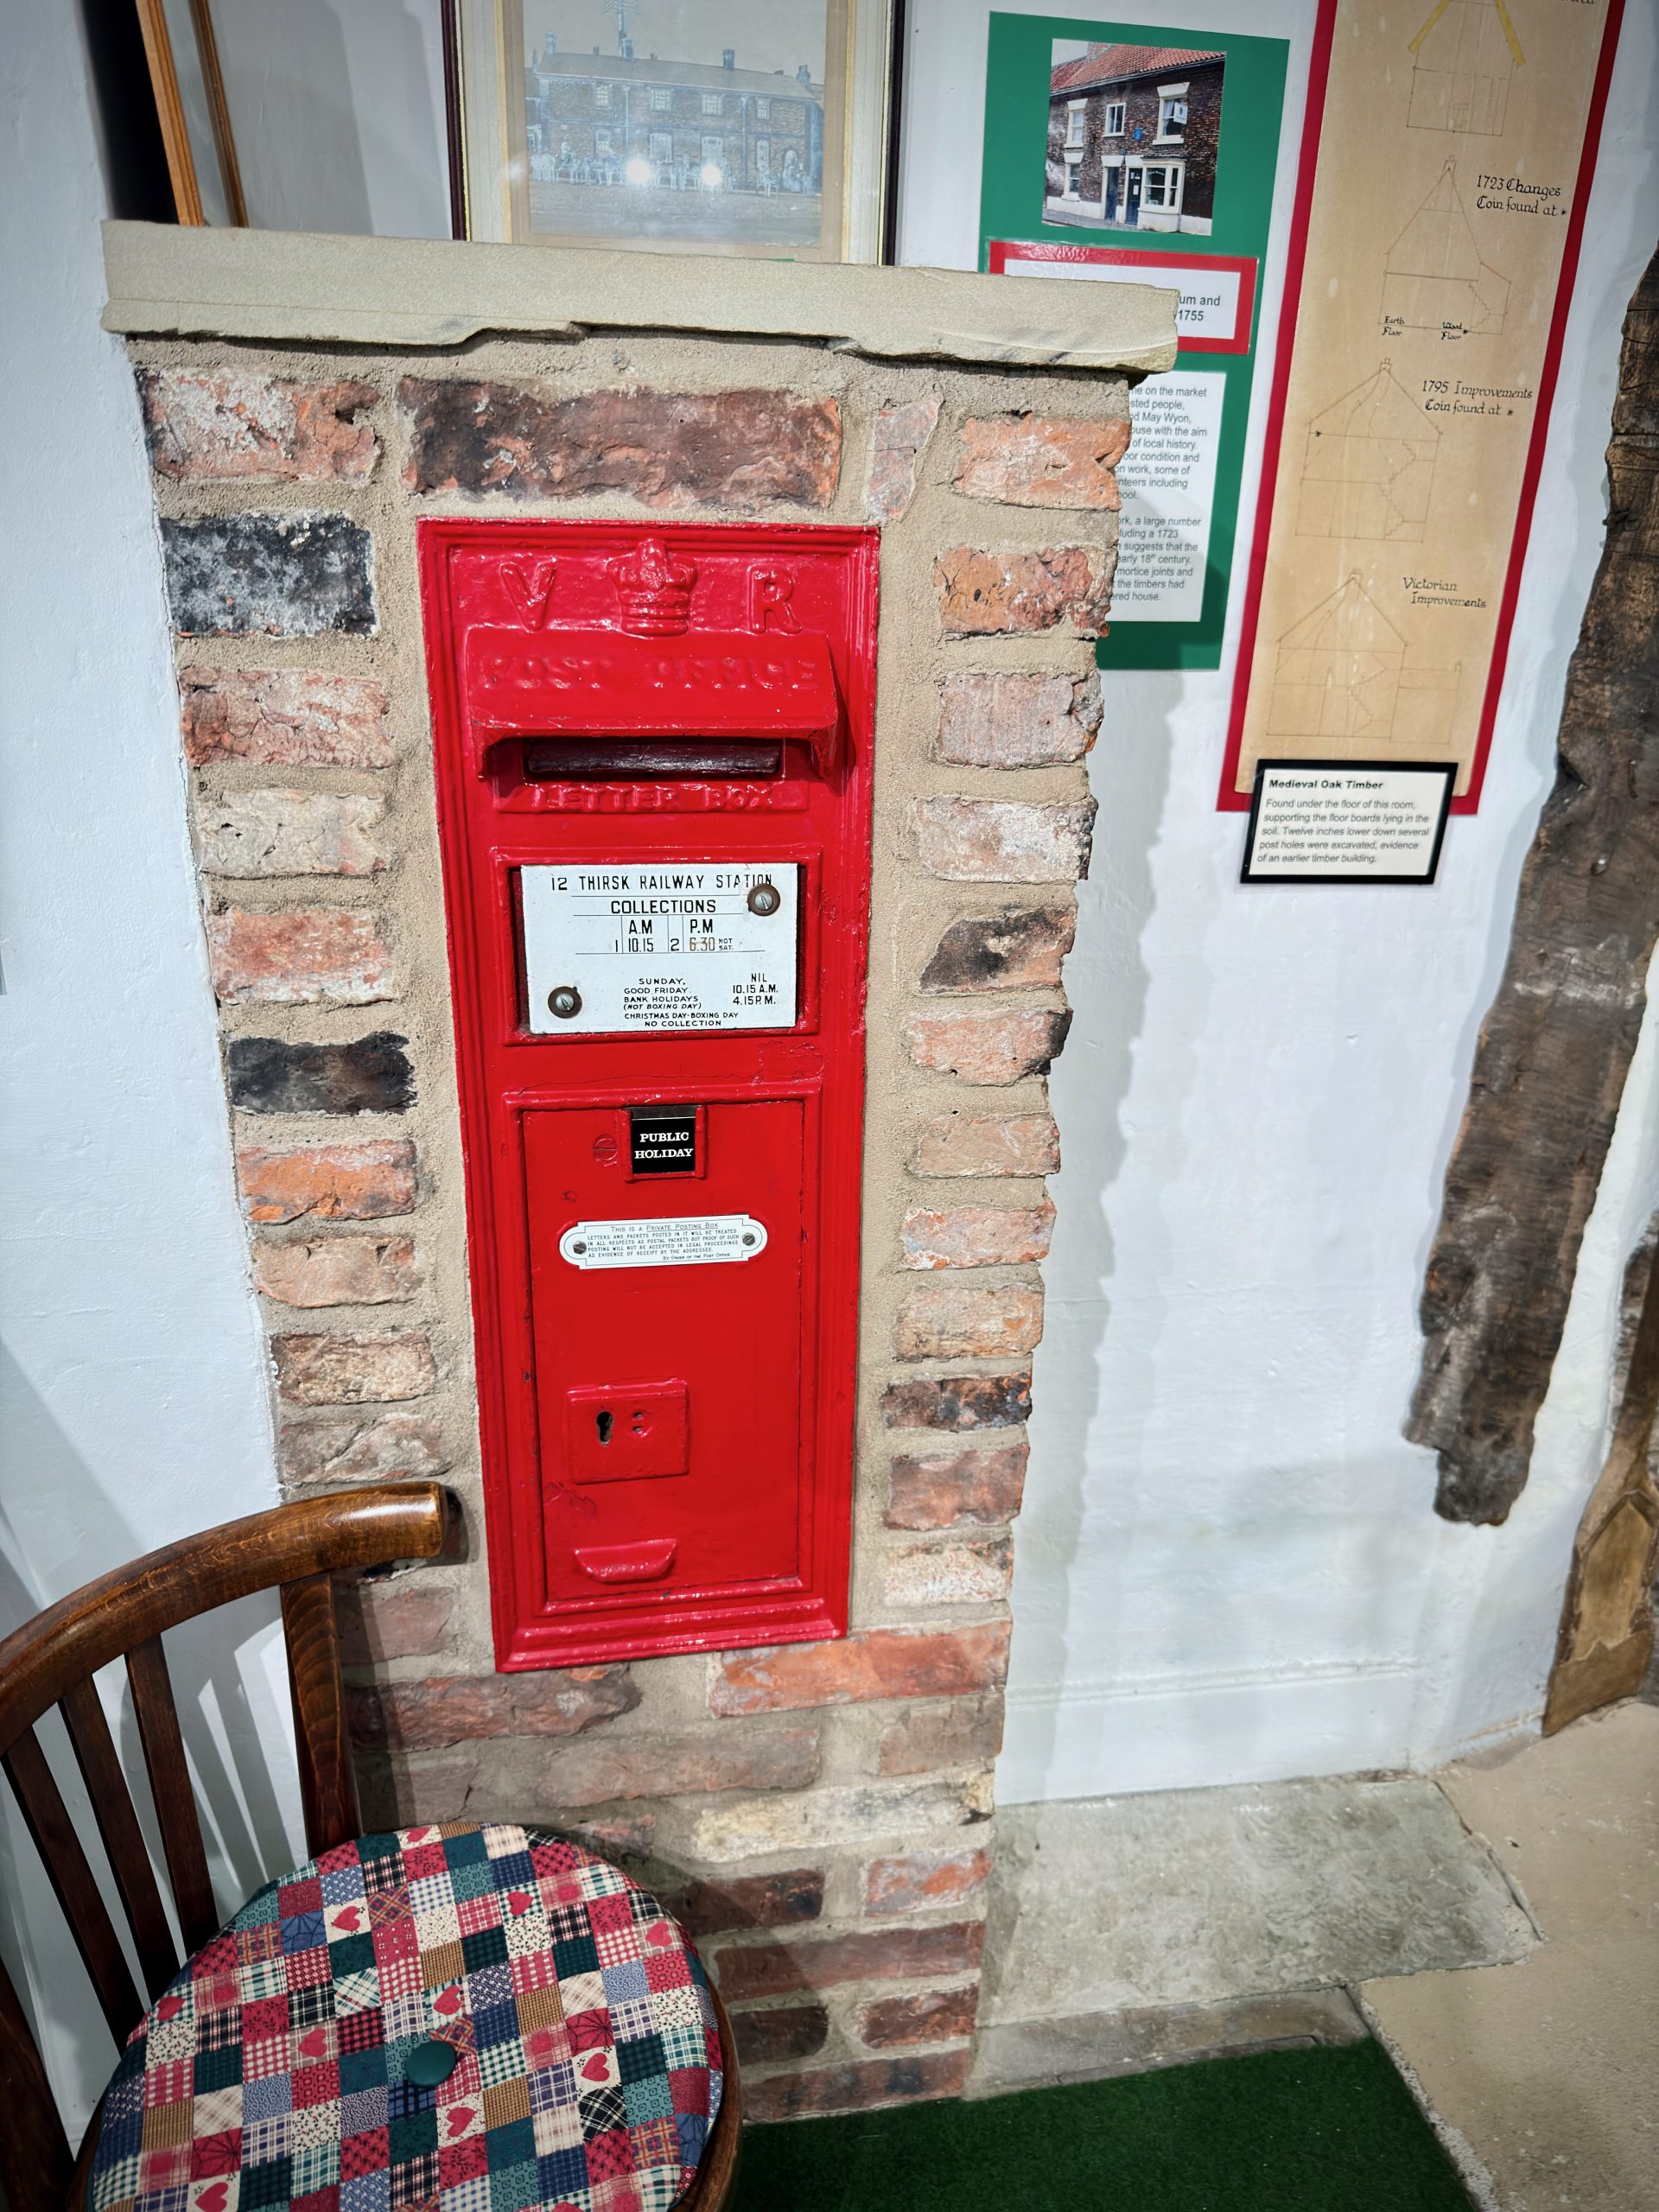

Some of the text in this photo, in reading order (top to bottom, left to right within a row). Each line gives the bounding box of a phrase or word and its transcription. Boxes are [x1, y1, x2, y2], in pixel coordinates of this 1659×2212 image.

[1477, 175, 1561, 200] 1723 Changes
[1477, 195, 1558, 216] Coin found at
[1199, 296, 1221, 306] and
[1159, 387, 1173, 396] the
[1175, 387, 1207, 397] market
[1422, 379, 1533, 399] 1795 Improvements
[1151, 400, 1185, 410] people,
[1425, 398, 1502, 415] Coin found at
[1141, 413, 1164, 423] May
[1154, 426, 1208, 436] with the aim
[1132, 439, 1141, 448] of
[1143, 440, 1164, 448] local
[1140, 453, 1200, 462] condition and
[1148, 479, 1188, 490] including
[1143, 517, 1202, 527] large number
[1157, 529, 1179, 538] 1723
[1123, 542, 1166, 553] suggests
[1166, 543, 1183, 551] that
[1184, 543, 1198, 551] the
[1116, 567, 1193, 578] mortice joints and
[1117, 580, 1185, 588] the timbers had
[1403, 577, 1458, 591] Victorian
[499, 561, 803, 636] V R
[480, 655, 820, 690] POST OFFICE
[1268, 779, 1317, 788] Medieval
[1345, 780, 1383, 790] Timber
[531, 784, 773, 810] LETTER BOX
[1265, 798, 1294, 808] Found
[1296, 799, 1323, 809] under
[1325, 799, 1338, 809] the
[1341, 799, 1361, 809] floor
[1362, 800, 1372, 809] of
[1373, 800, 1389, 809] this
[1263, 814, 1310, 823] supporting
[1312, 814, 1327, 823] the
[1328, 814, 1348, 823] floor
[1351, 814, 1381, 823] boards
[1382, 815, 1402, 824] lying
[1414, 815, 1429, 823] the
[1281, 827, 1313, 836] Twelve
[1315, 827, 1344, 836] inches
[1346, 827, 1370, 836] lower
[1397, 828, 1430, 836] several
[1259, 841, 1279, 850] post
[1280, 841, 1305, 849] holes
[1380, 842, 1419, 850] evidence
[1257, 854, 1267, 862] of
[1281, 854, 1310, 862] earlier
[1312, 854, 1340, 862] timber
[551, 874, 772, 891] 12 THIRSK RAILWAY STATION
[611, 899, 716, 914] COLLECTIONS
[628, 919, 652, 934] A.M
[690, 918, 714, 933] P.M
[628, 938, 654, 952] 10.15
[670, 938, 715, 951] 2 6.30
[751, 973, 767, 982] NIL
[639, 1132, 690, 1143] PUBLIC
[634, 1148, 694, 1159] HOLIDAY
